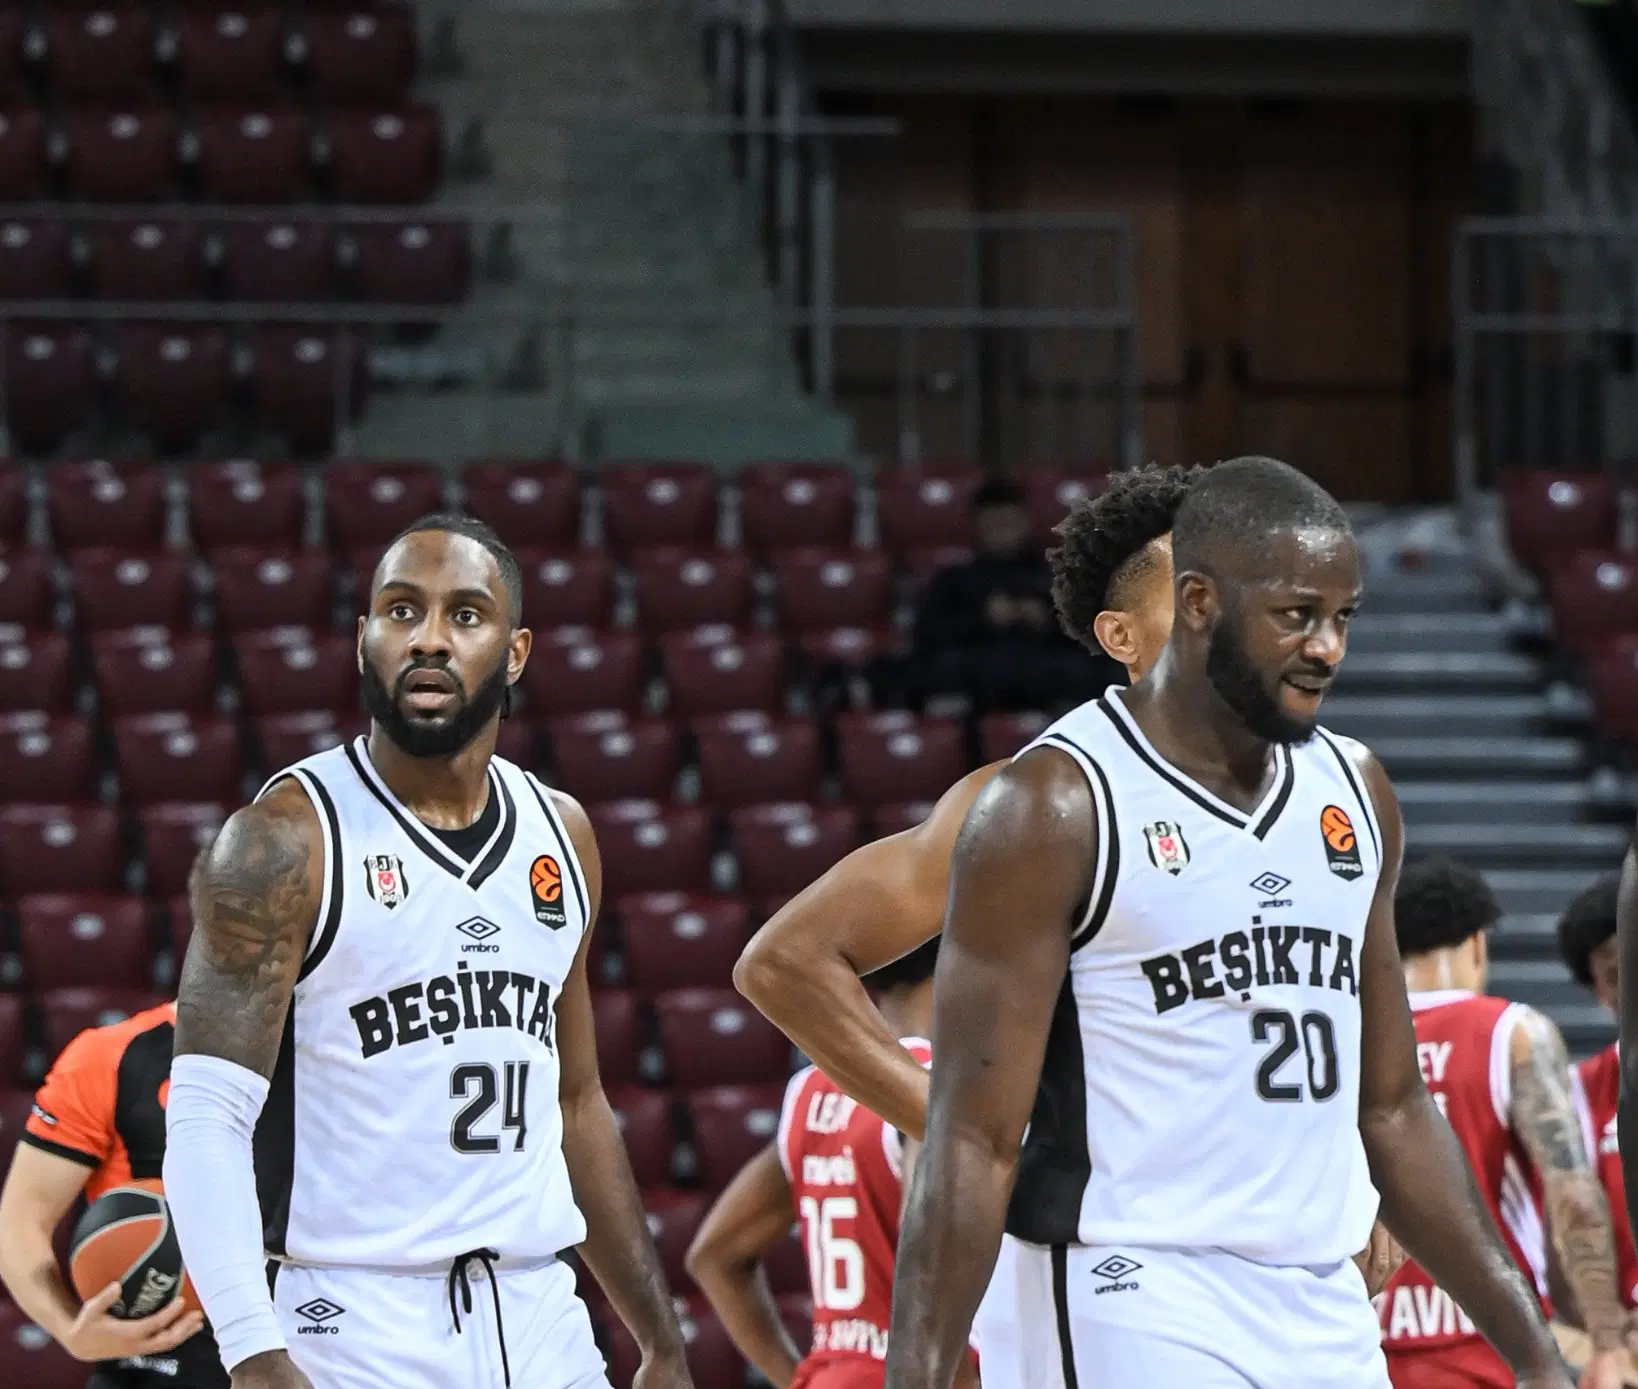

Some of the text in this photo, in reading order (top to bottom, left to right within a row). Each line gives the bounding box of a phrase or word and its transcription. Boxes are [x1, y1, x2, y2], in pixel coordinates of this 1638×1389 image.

[461, 943, 500, 953] umbro
[1141, 915, 1360, 1014] BEŞİKTA
[1249, 1008, 1341, 1103] 20
[449, 1061, 530, 1154] 24
[800, 1196, 865, 1310] 16
[1094, 1281, 1139, 1294] umbro
[298, 1324, 339, 1335] umbro
